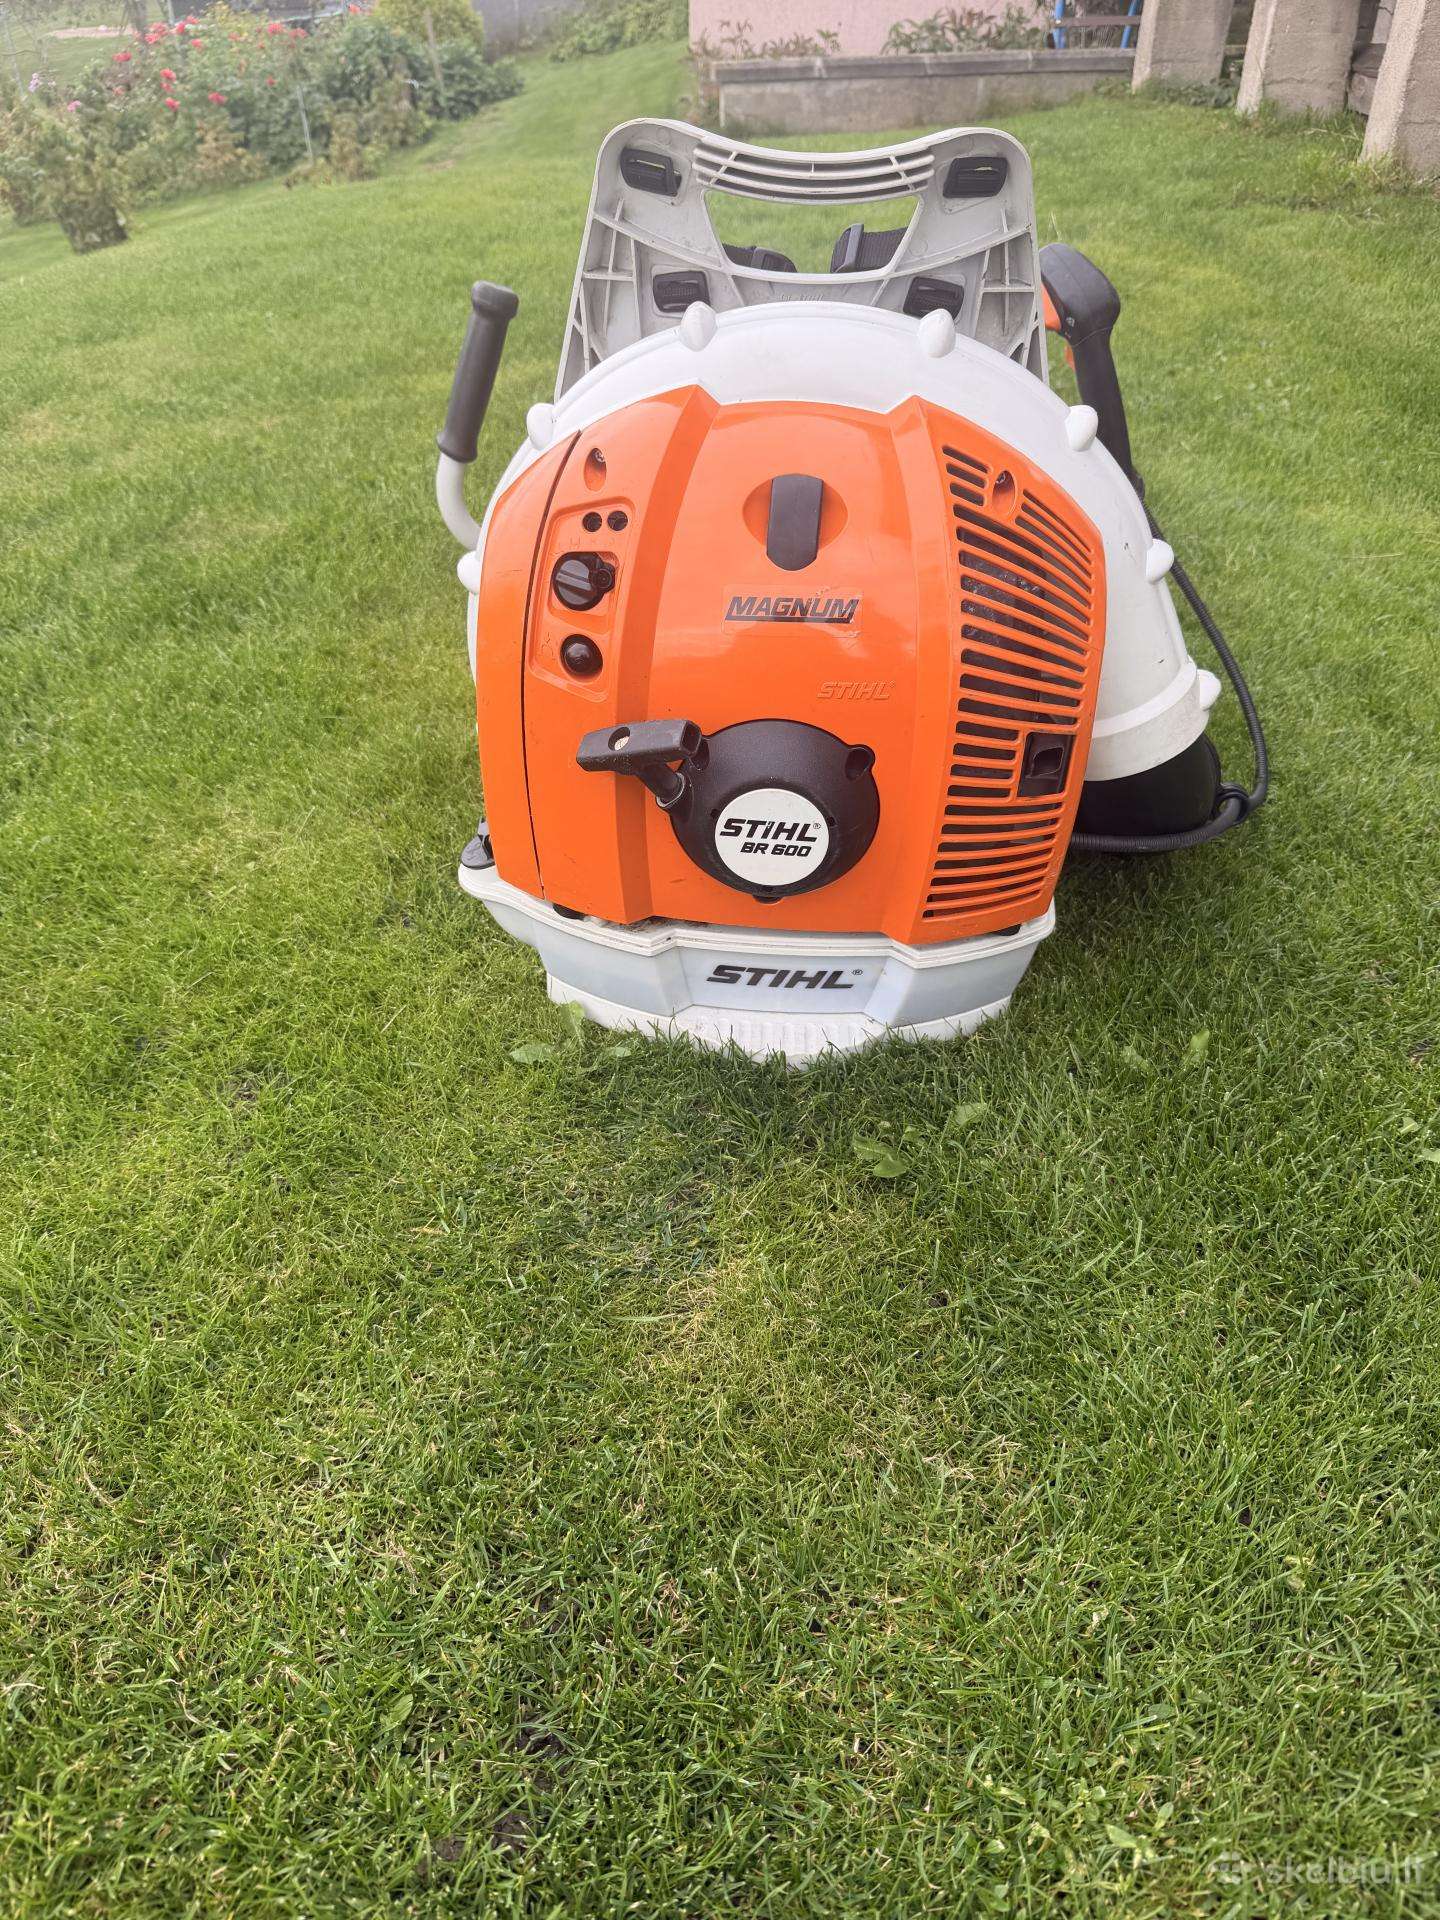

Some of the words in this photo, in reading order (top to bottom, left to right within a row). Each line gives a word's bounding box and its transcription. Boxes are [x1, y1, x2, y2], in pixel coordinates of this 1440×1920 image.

[725, 596, 860, 619] MAGNUM
[741, 842, 767, 855] BR
[771, 843, 812, 858] 600
